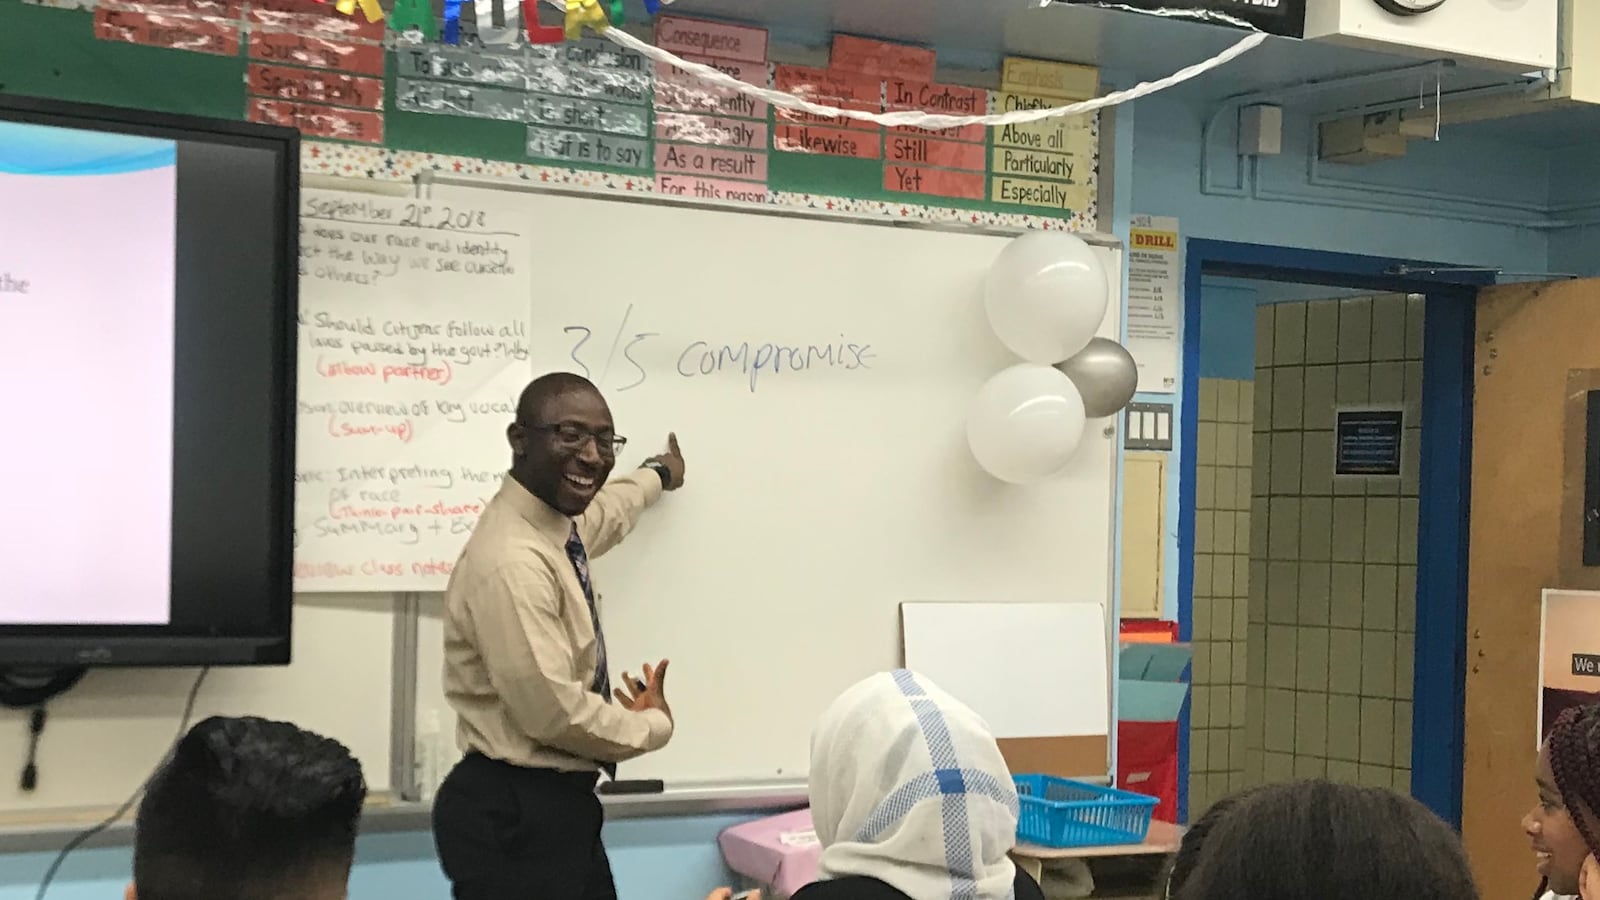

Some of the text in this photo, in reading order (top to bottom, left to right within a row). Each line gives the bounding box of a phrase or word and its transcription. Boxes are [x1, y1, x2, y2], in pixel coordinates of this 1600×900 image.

[660, 19, 740, 54] Consequence
[894, 82, 977, 112] In Contrast
[784, 125, 857, 156] Likewise
[1001, 124, 1064, 149] Above all
[596, 138, 611, 160] to
[616, 146, 642, 168] say
[663, 145, 756, 176] As a result
[894, 138, 928, 162] Still
[1003, 150, 1075, 180] Particularly
[660, 176, 766, 203] For this reason
[895, 166, 922, 191] Yet
[1001, 180, 1068, 208] Especially
[350, 231, 378, 244] our
[385, 234, 421, 249] race
[425, 239, 451, 254] and
[1136, 233, 1174, 249] DRILL
[314, 311, 376, 336] Should
[446, 320, 495, 338] follow
[498, 318, 525, 338] all
[405, 342, 427, 366] by
[431, 341, 457, 357] the
[564, 303, 660, 392] 3/5
[410, 399, 430, 417] of
[335, 463, 453, 489] Interpreting
[359, 488, 400, 503] race
[1574, 656, 1594, 673] We
